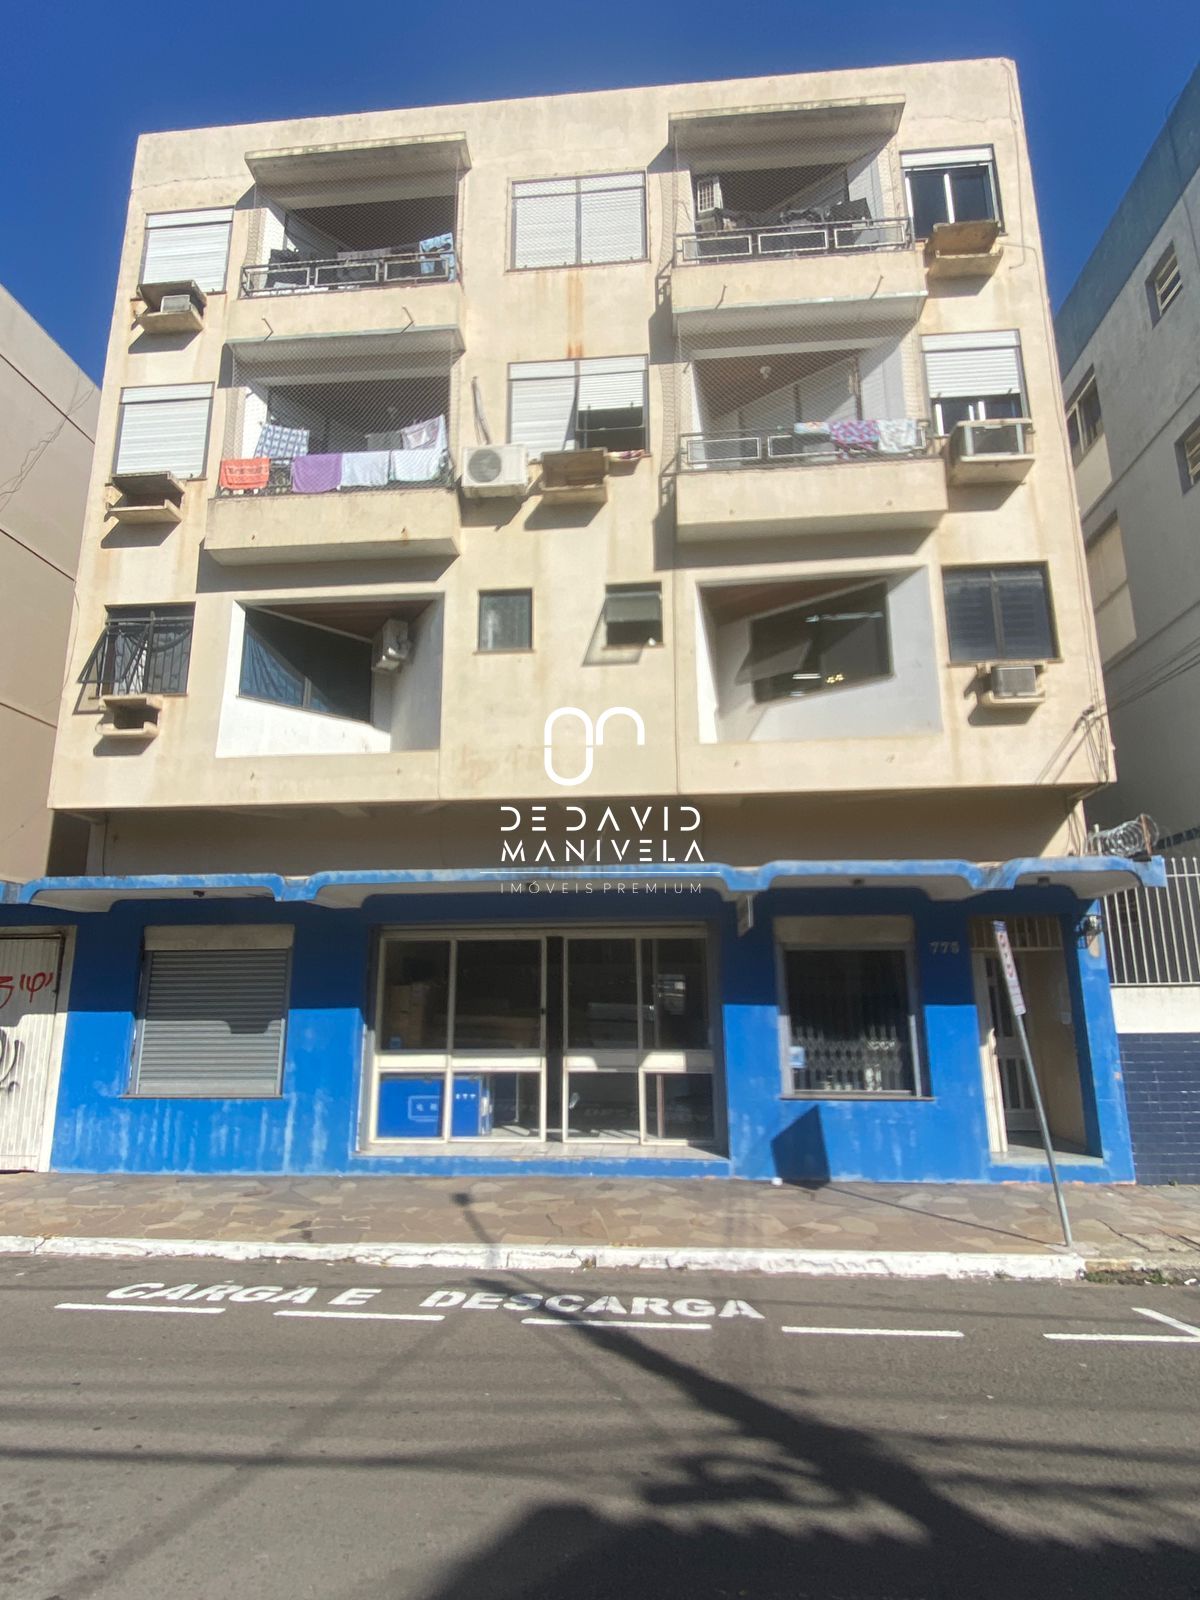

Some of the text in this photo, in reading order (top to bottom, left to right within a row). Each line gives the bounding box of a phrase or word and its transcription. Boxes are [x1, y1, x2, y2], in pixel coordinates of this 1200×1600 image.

[106, 1283, 766, 1319] CARGA E DESCARGA
